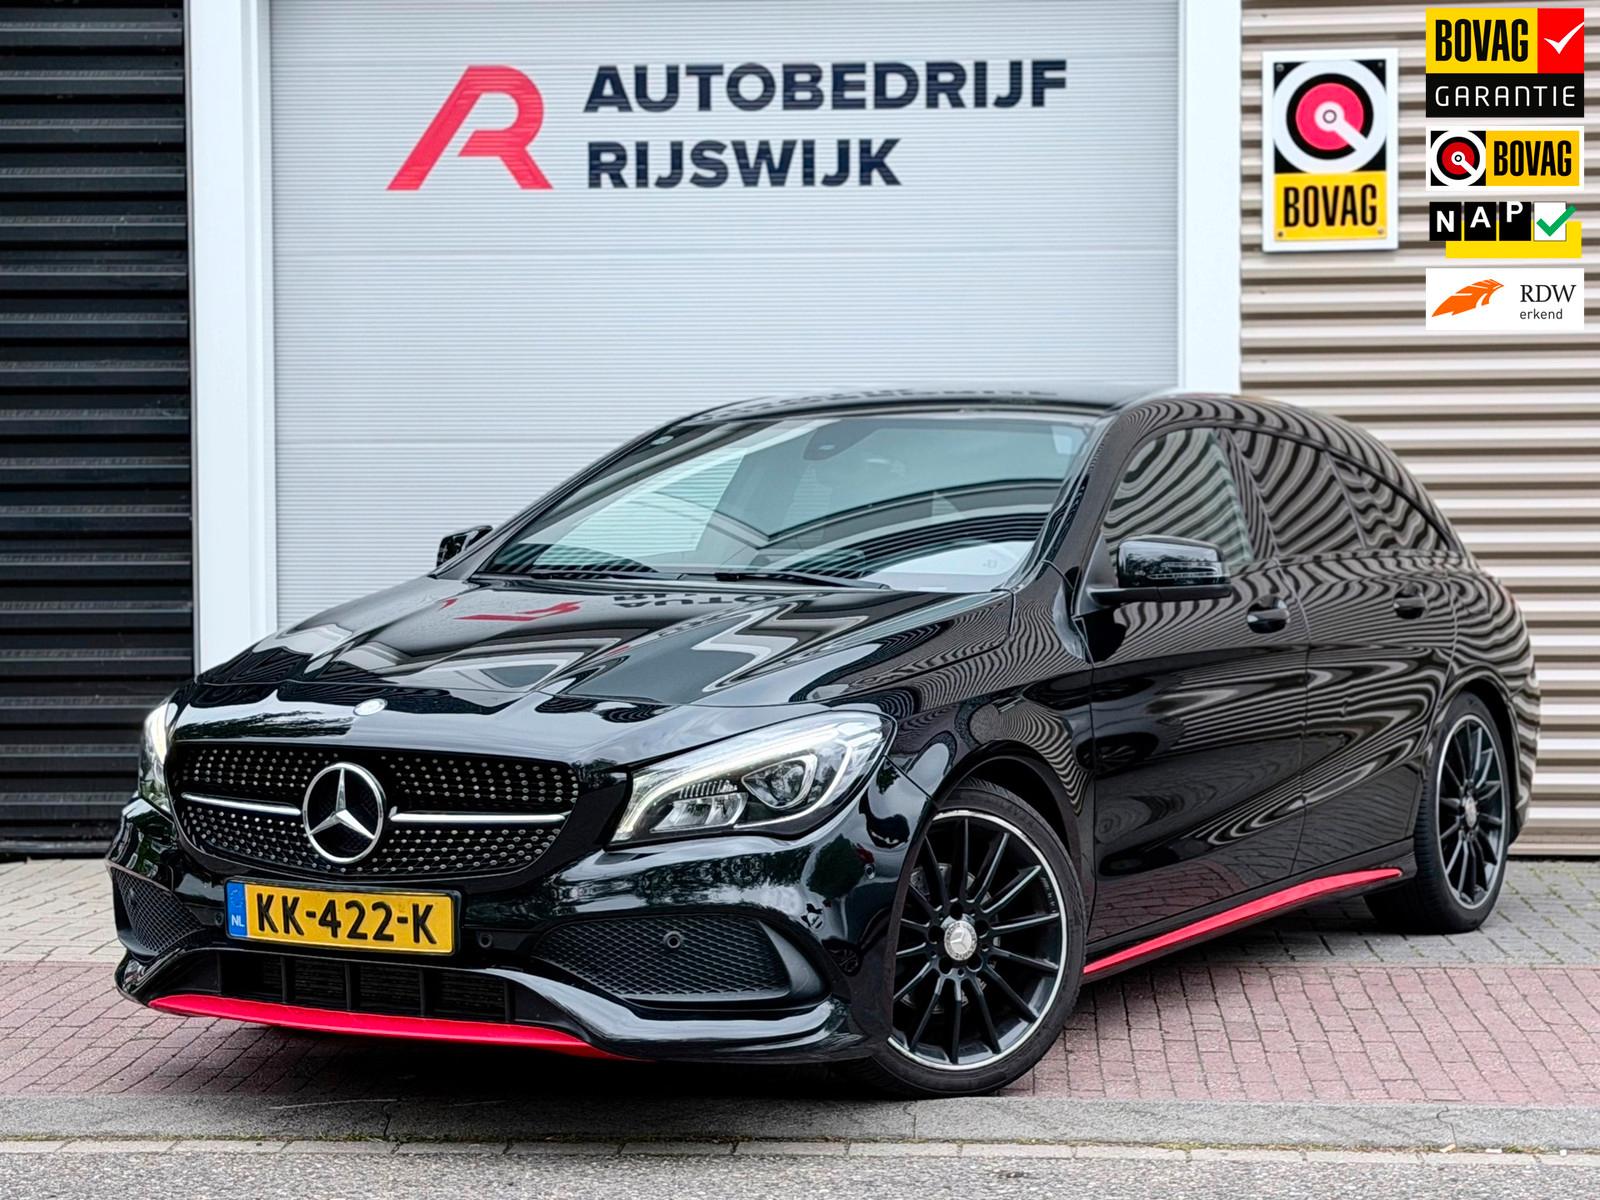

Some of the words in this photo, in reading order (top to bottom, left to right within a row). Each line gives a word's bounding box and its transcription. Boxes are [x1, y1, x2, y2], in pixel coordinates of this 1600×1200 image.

[584, 59, 1067, 112] AUTOBEDRIJF
[587, 138, 902, 189] RIJSWIJK
[1283, 184, 1377, 228] BOVAG
[231, 915, 245, 927] NL
[256, 893, 437, 944] KK-422-K
